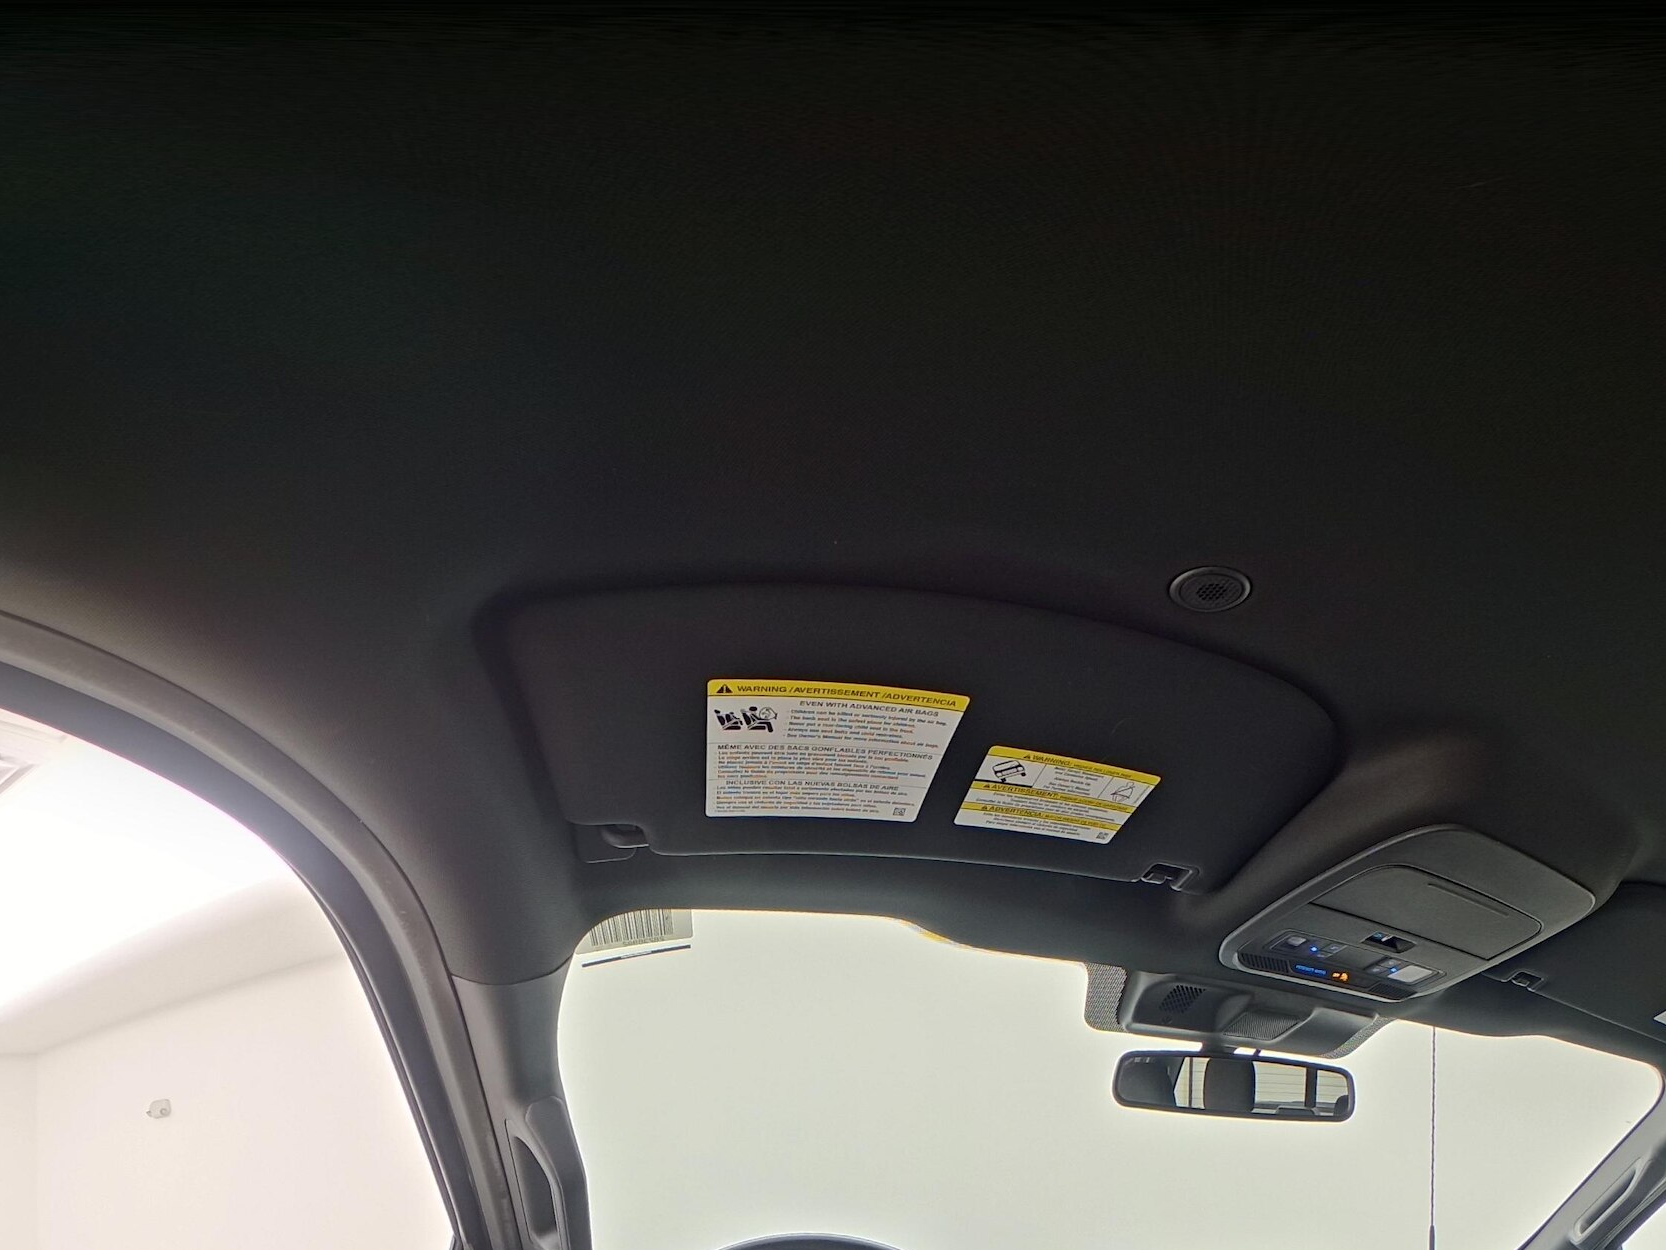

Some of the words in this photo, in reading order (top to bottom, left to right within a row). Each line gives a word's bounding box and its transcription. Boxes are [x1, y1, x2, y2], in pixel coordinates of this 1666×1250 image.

[737, 685, 787, 693] WARNING
[850, 703, 898, 713] ADVANCED
[915, 709, 939, 717] BAGS
